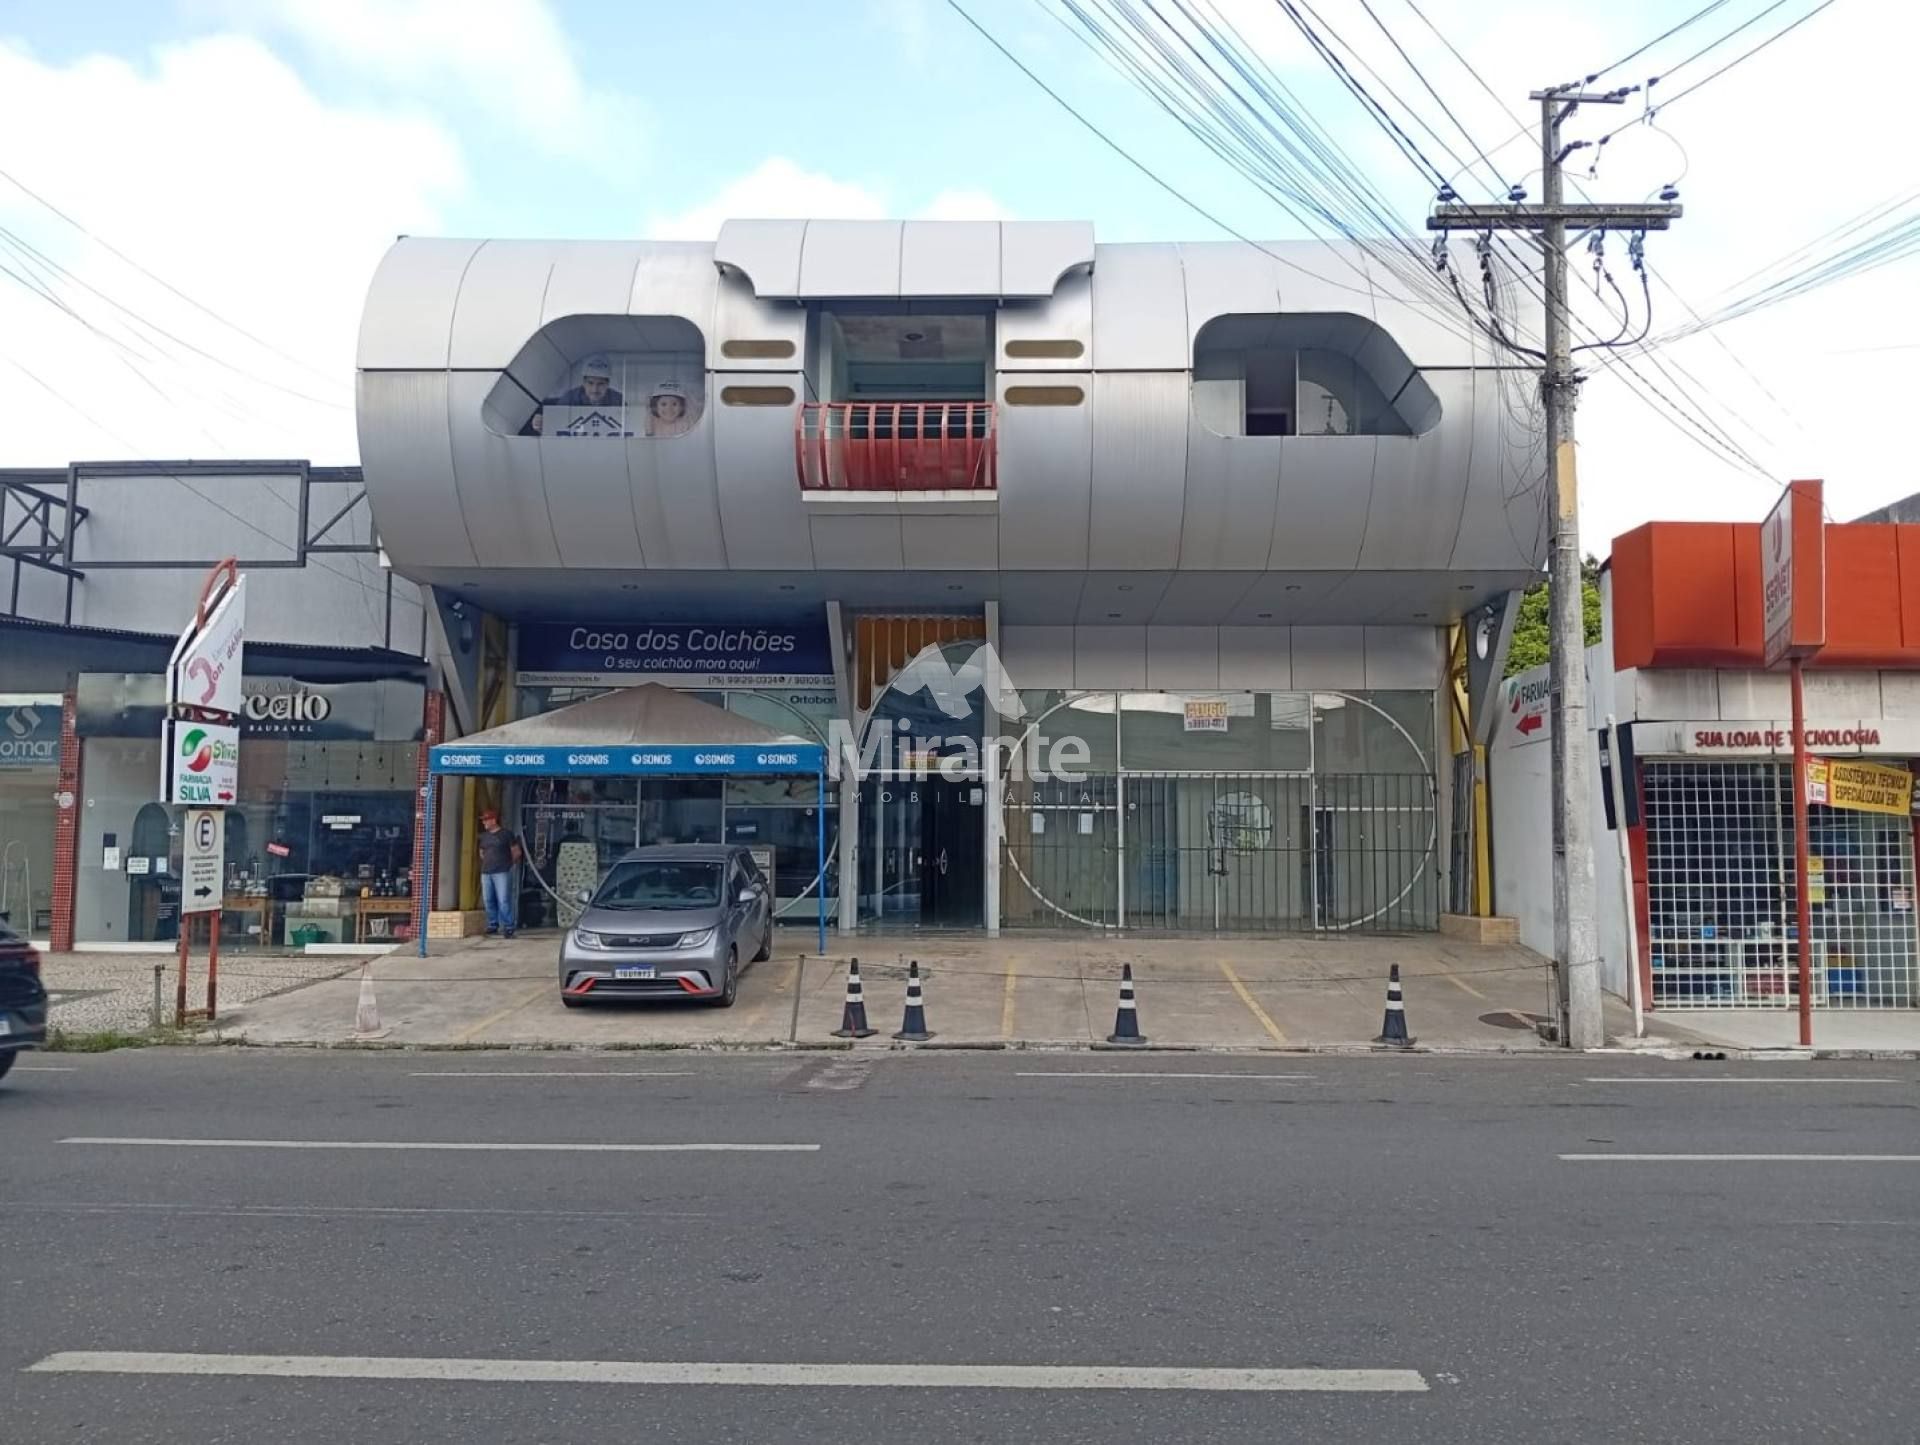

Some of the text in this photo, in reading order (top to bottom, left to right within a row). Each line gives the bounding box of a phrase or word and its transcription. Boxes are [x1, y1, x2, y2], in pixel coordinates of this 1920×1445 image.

[569, 627, 797, 651] Casa dos Colchões
[604, 655, 761, 672] O seu colchão mora aqui!
[1695, 729, 1880, 748] SUA LOJA DE TCNOLOGIA
[451, 754, 798, 765] SONOS SONOS SONOS SONOS SONOS SONOS
[180, 786, 211, 802] SILVA
[201, 819, 210, 847] E
